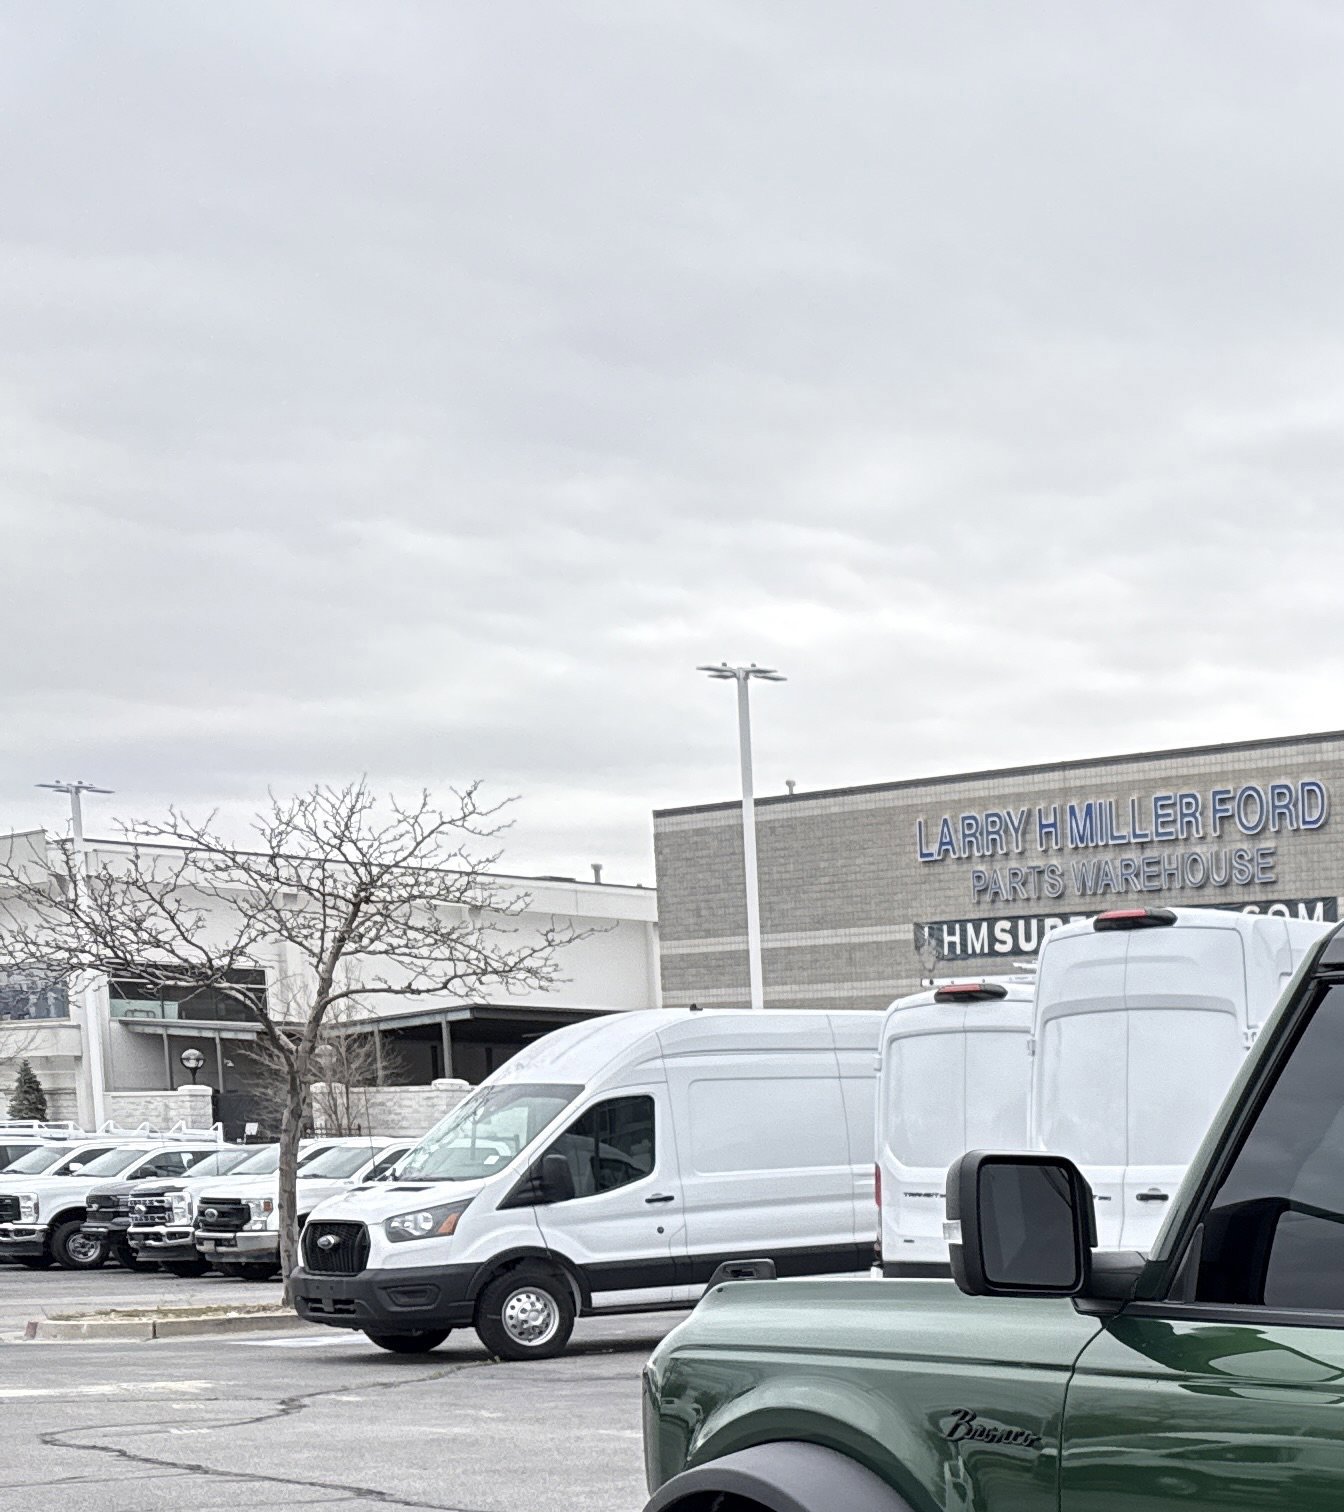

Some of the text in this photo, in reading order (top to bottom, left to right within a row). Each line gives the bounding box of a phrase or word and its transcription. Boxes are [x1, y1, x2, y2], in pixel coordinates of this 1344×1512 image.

[917, 779, 1329, 862] LARRY H MILLER FORD
[972, 846, 1277, 901] PARTS WAREHOUSE
[944, 1407, 1042, 1447] Bronco
